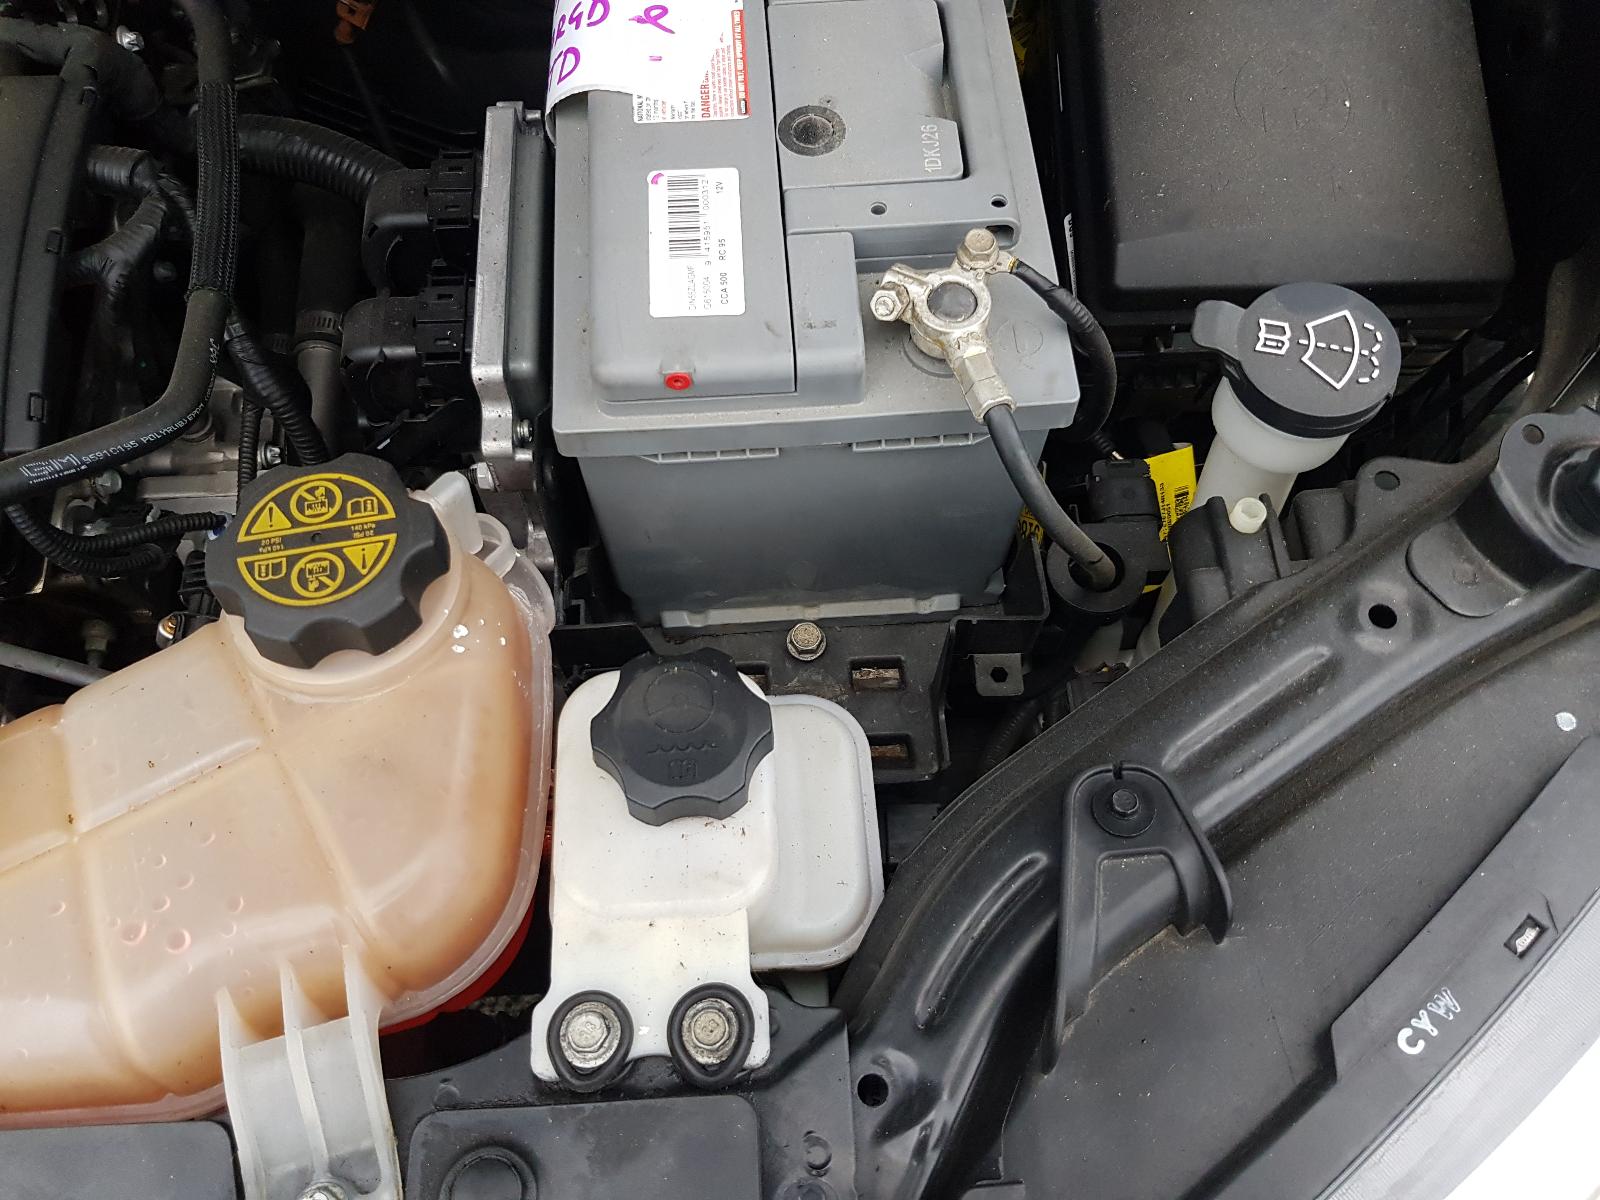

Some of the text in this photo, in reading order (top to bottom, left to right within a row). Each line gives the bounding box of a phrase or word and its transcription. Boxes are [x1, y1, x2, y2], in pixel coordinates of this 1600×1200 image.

[700, 84, 710, 118] DANGER
[716, 182, 729, 305] CCA 500 RC 95 12V
